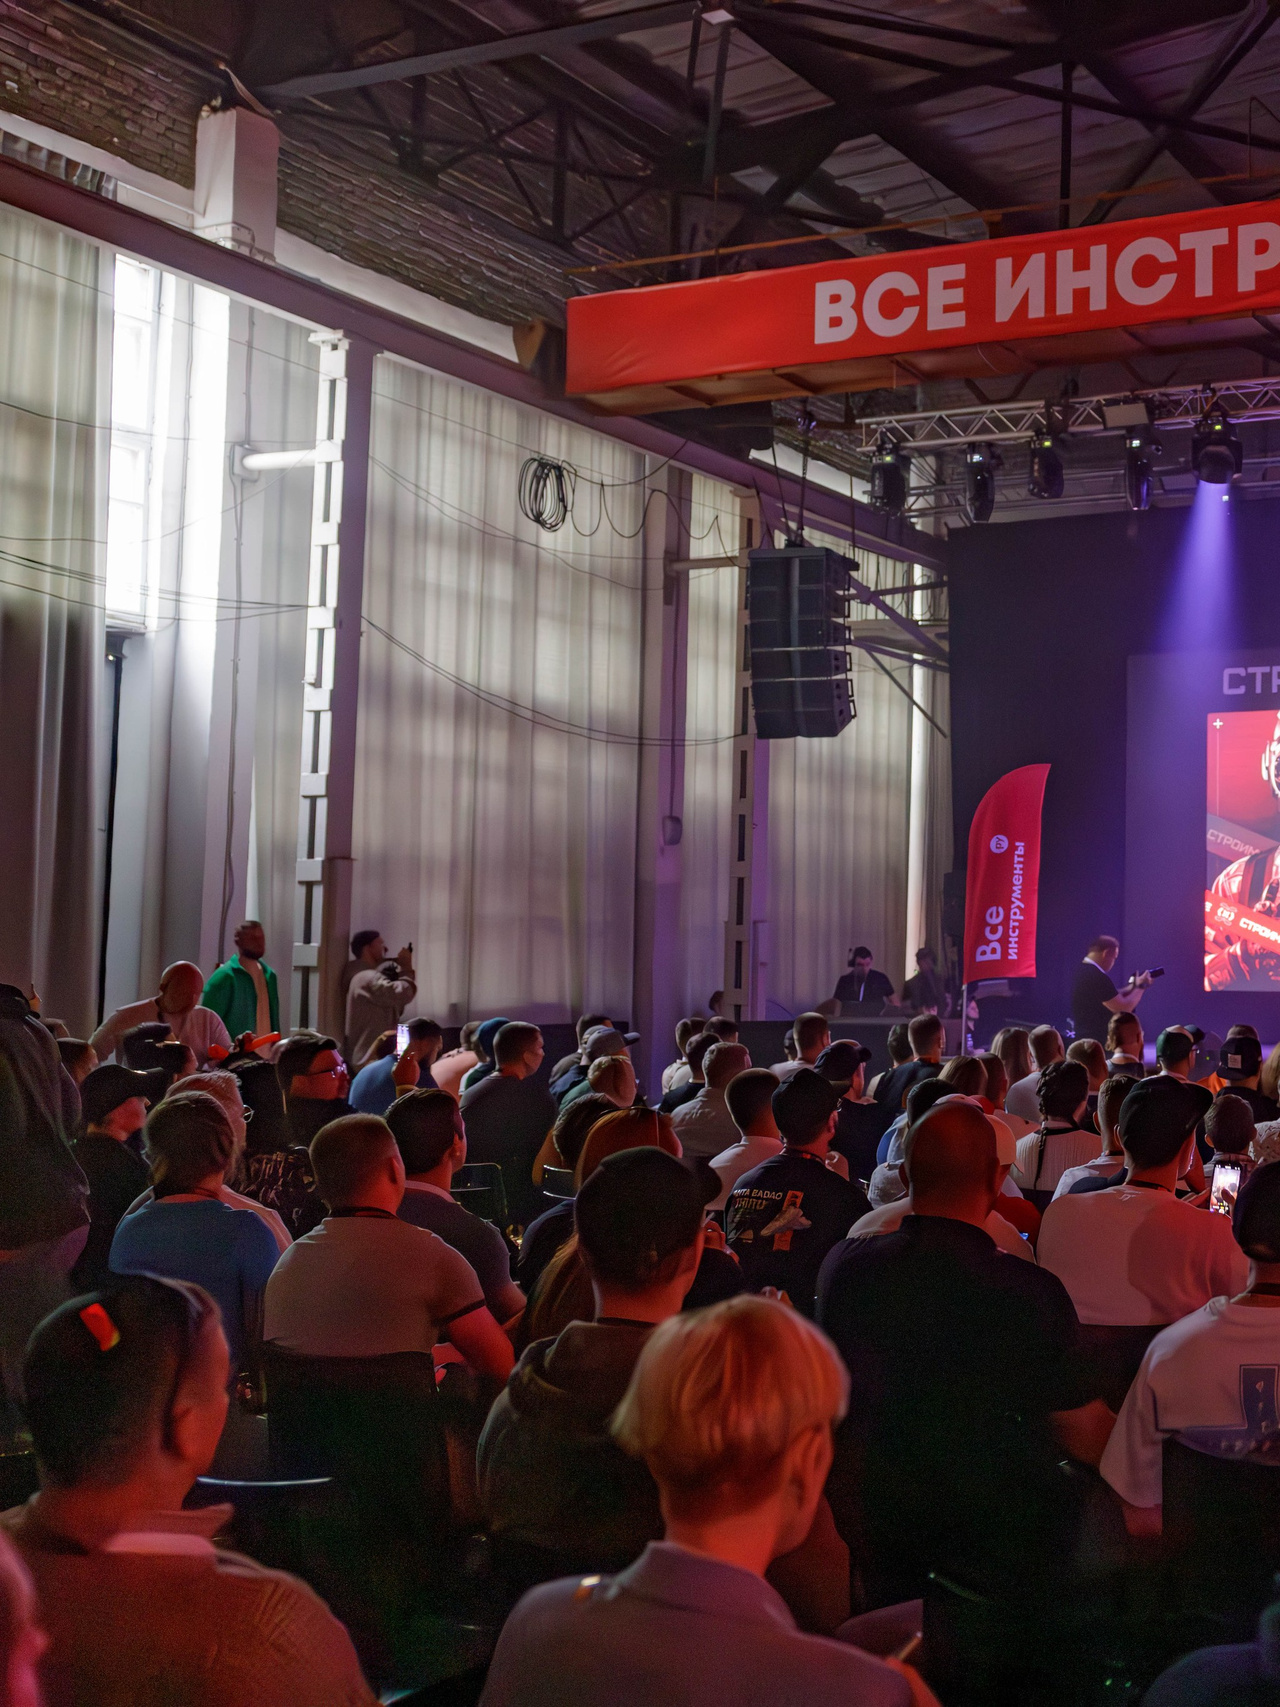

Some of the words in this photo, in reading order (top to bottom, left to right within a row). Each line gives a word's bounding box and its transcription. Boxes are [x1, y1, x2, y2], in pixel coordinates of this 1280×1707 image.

[813, 263, 967, 345] ВСЕ
[975, 905, 1004, 962] Все
[1008, 841, 1025, 960] инструменты
